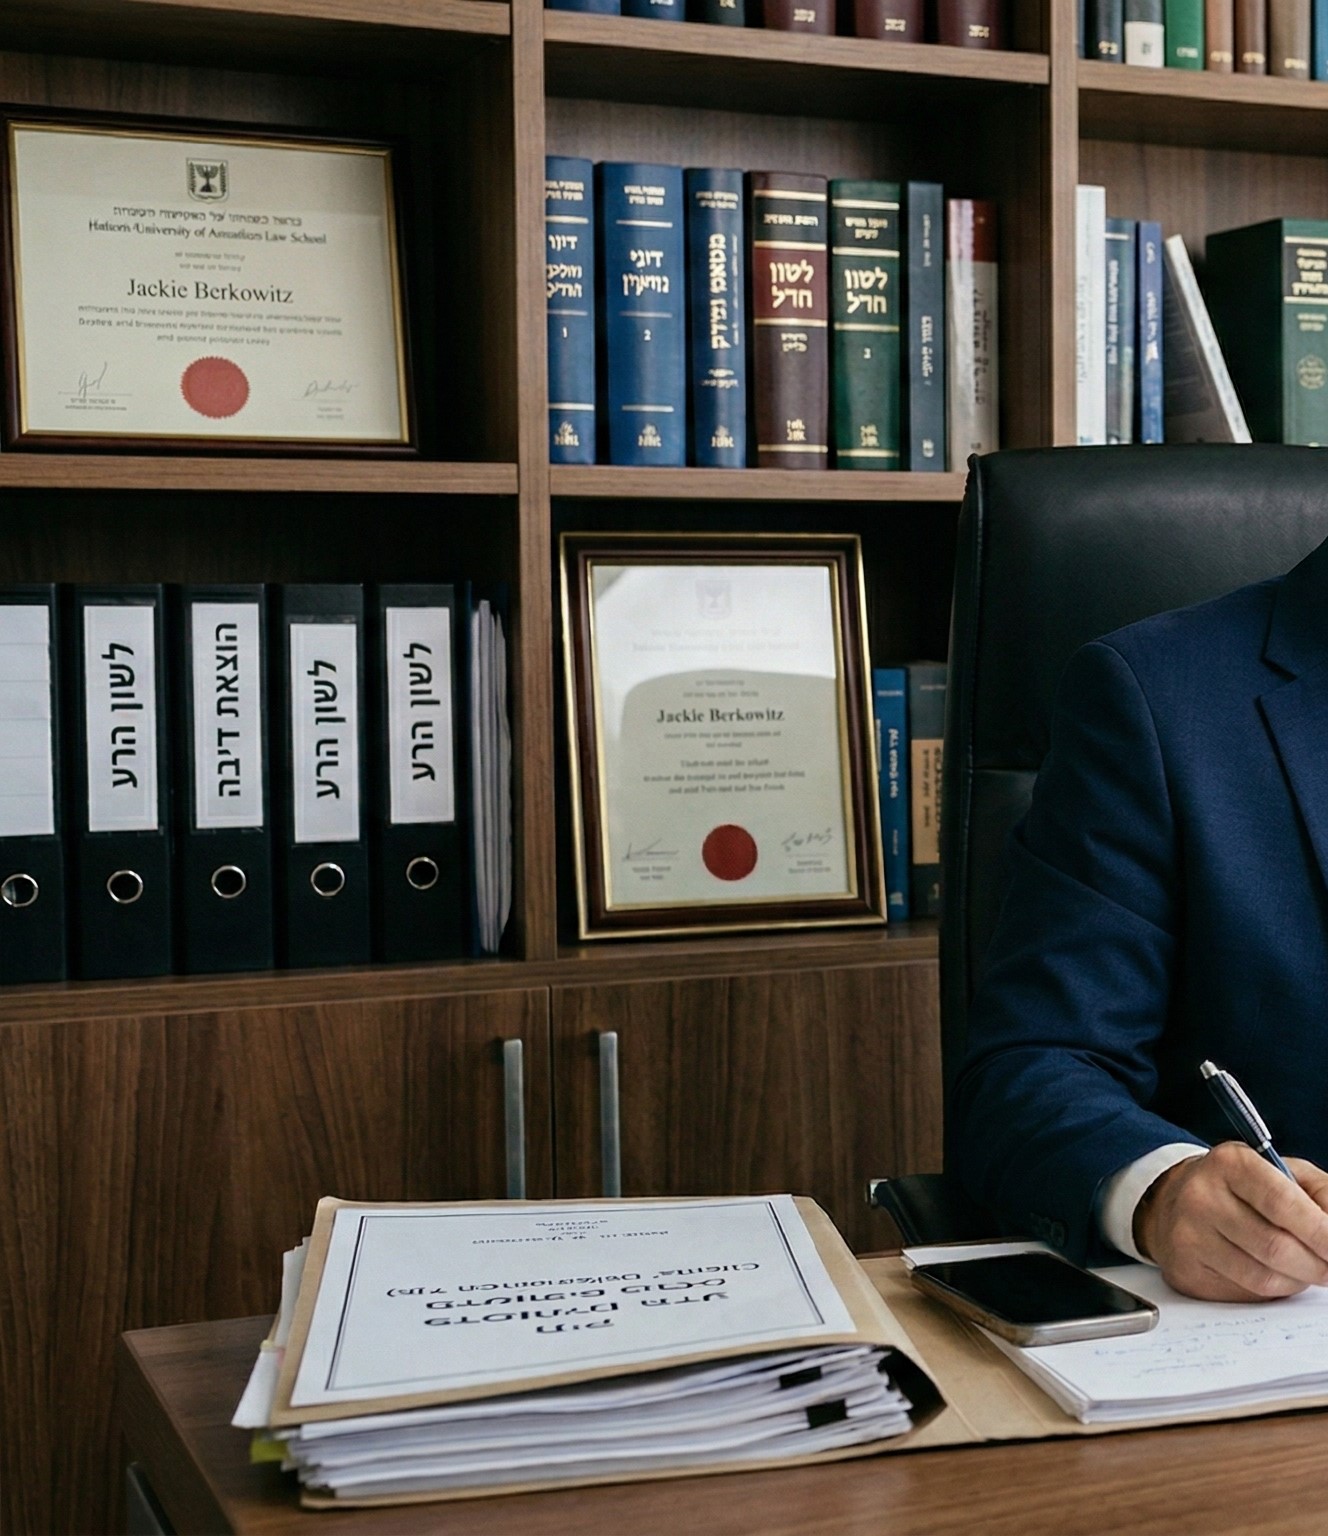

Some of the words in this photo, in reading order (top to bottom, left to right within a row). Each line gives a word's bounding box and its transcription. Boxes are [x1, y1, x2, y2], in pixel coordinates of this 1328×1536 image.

[194, 226, 205, 238] of
[127, 278, 188, 299] Jackie
[194, 281, 294, 303] Berkowitz
[102, 642, 144, 712] לשון
[215, 623, 240, 718] הוצאת
[306, 659, 347, 726] לשון
[402, 642, 441, 708] לשון
[657, 708, 705, 723] Jackie
[709, 707, 785, 722] Berkowitz
[110, 726, 138, 789] הרע
[217, 727, 241, 797] דיבה
[315, 738, 340, 800] הרע
[411, 721, 436, 781] הרע
